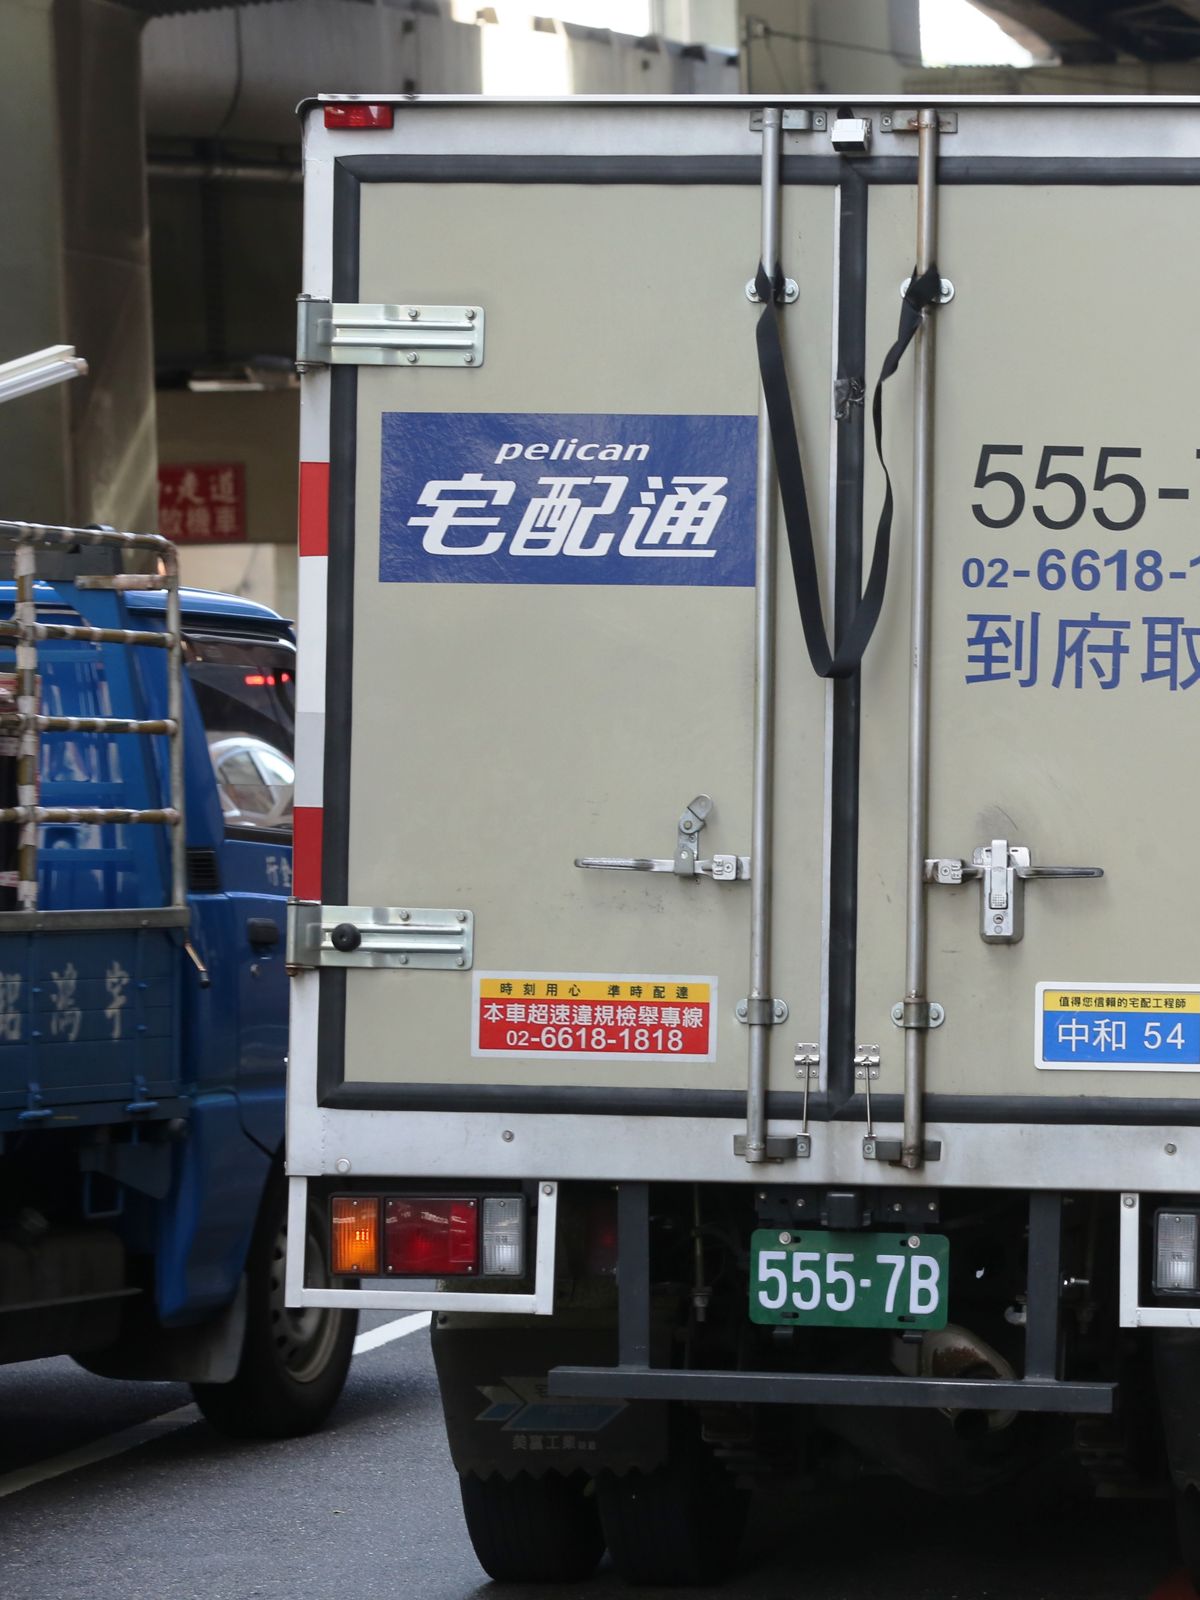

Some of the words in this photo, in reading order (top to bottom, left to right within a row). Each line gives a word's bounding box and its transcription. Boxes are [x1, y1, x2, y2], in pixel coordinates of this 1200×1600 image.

[494, 438, 650, 464] pelican
[407, 473, 728, 558] 宅配通
[500, 983, 581, 997] 時刻用心
[607, 984, 689, 999] 準時配達
[1059, 996, 1187, 1009] 值得您信賴的宅配工程師
[483, 1002, 704, 1029] 本車超速違規檢舉專線
[506, 1025, 684, 1051] 02-6618-1818
[1058, 1018, 1126, 1052] 中和
[1143, 1022, 1185, 1050] 54
[758, 1250, 940, 1314] 555-7B
